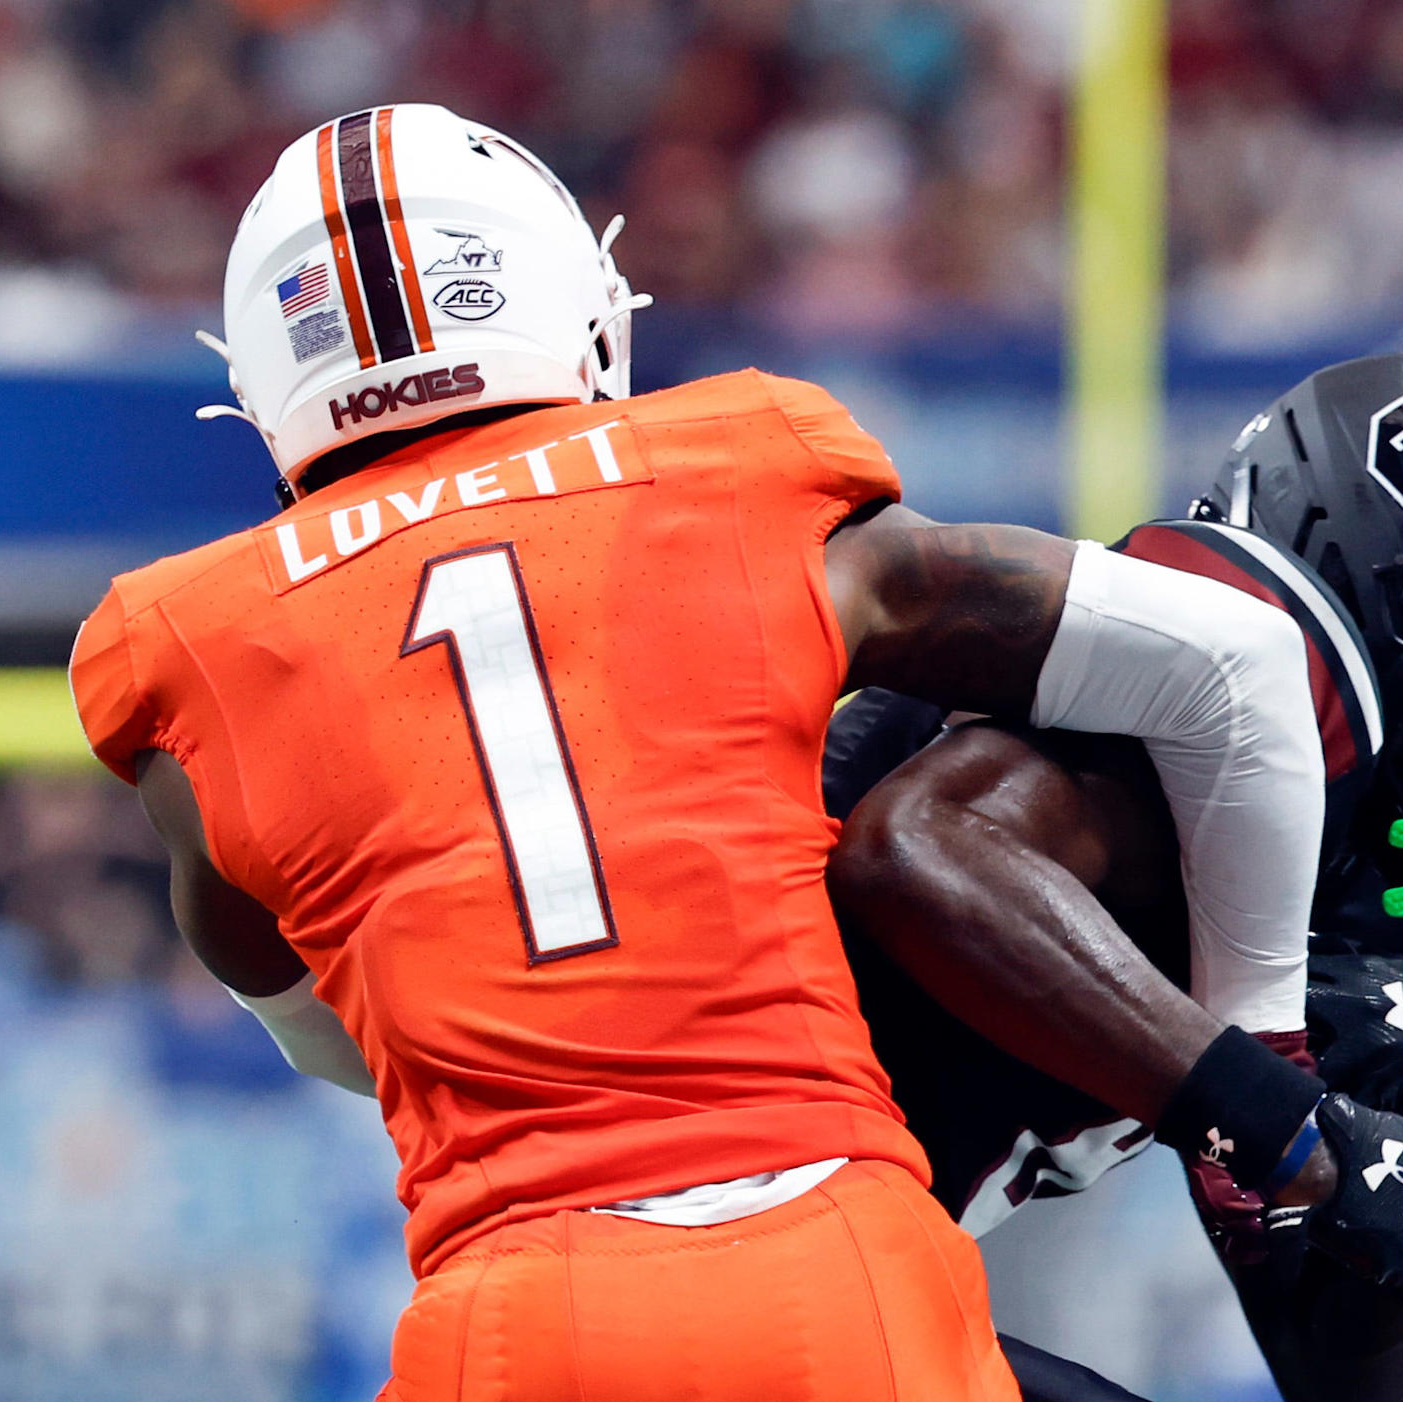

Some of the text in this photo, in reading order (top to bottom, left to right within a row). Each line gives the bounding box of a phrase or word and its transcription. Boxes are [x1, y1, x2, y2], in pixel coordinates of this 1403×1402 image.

[461, 252, 486, 267] VT
[444, 289, 494, 304] ACC
[329, 363, 485, 430] HOKIES
[277, 421, 622, 582] LOVETT
[400, 541, 619, 966] 1
